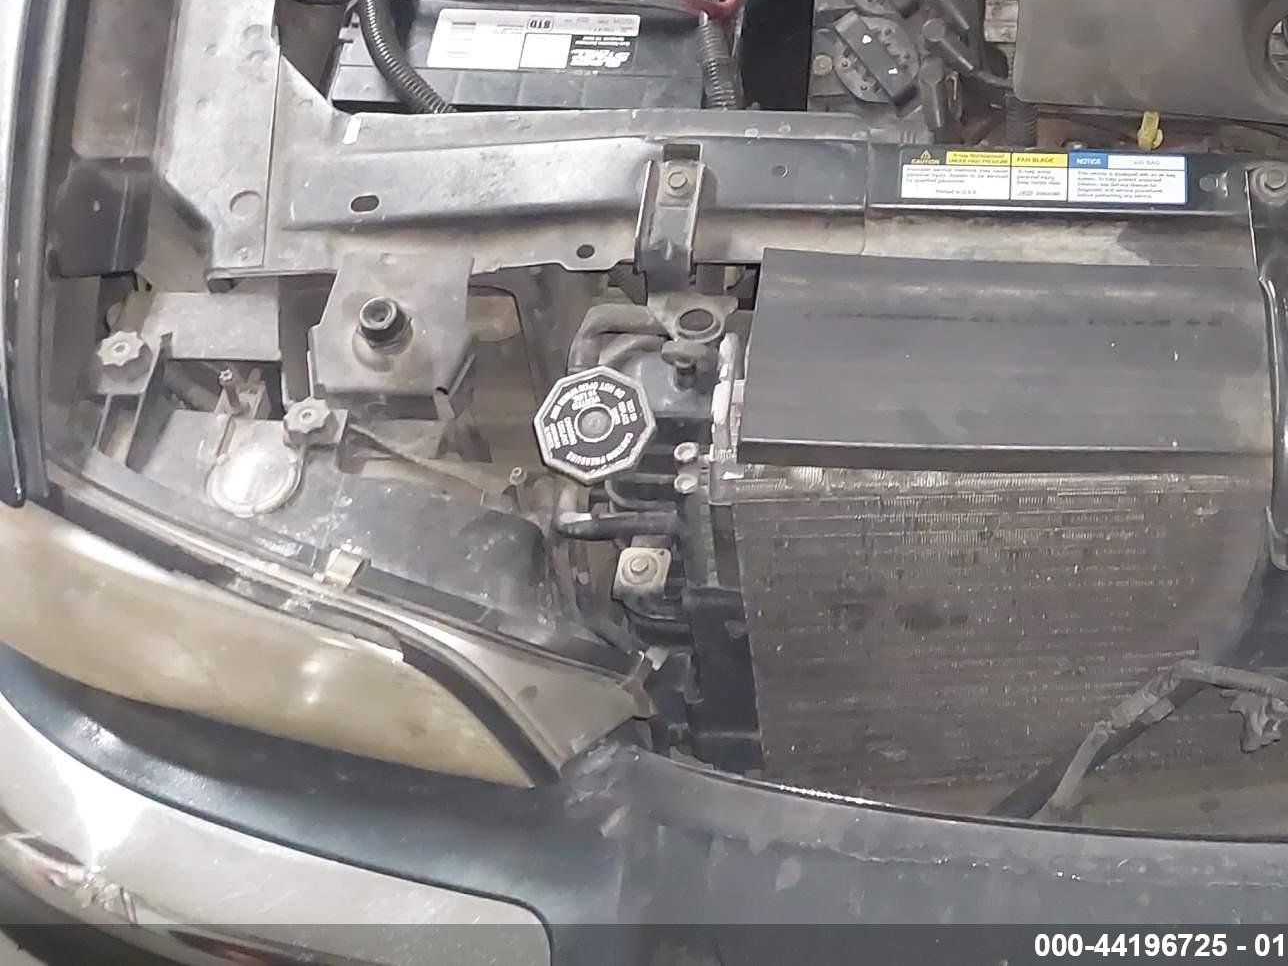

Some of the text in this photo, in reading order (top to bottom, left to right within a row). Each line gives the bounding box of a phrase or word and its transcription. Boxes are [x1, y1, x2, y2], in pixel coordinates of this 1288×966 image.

[1076, 157, 1102, 165] NOTICE
[598, 381, 616, 394] NOT
[565, 451, 607, 466] PRESSURE
